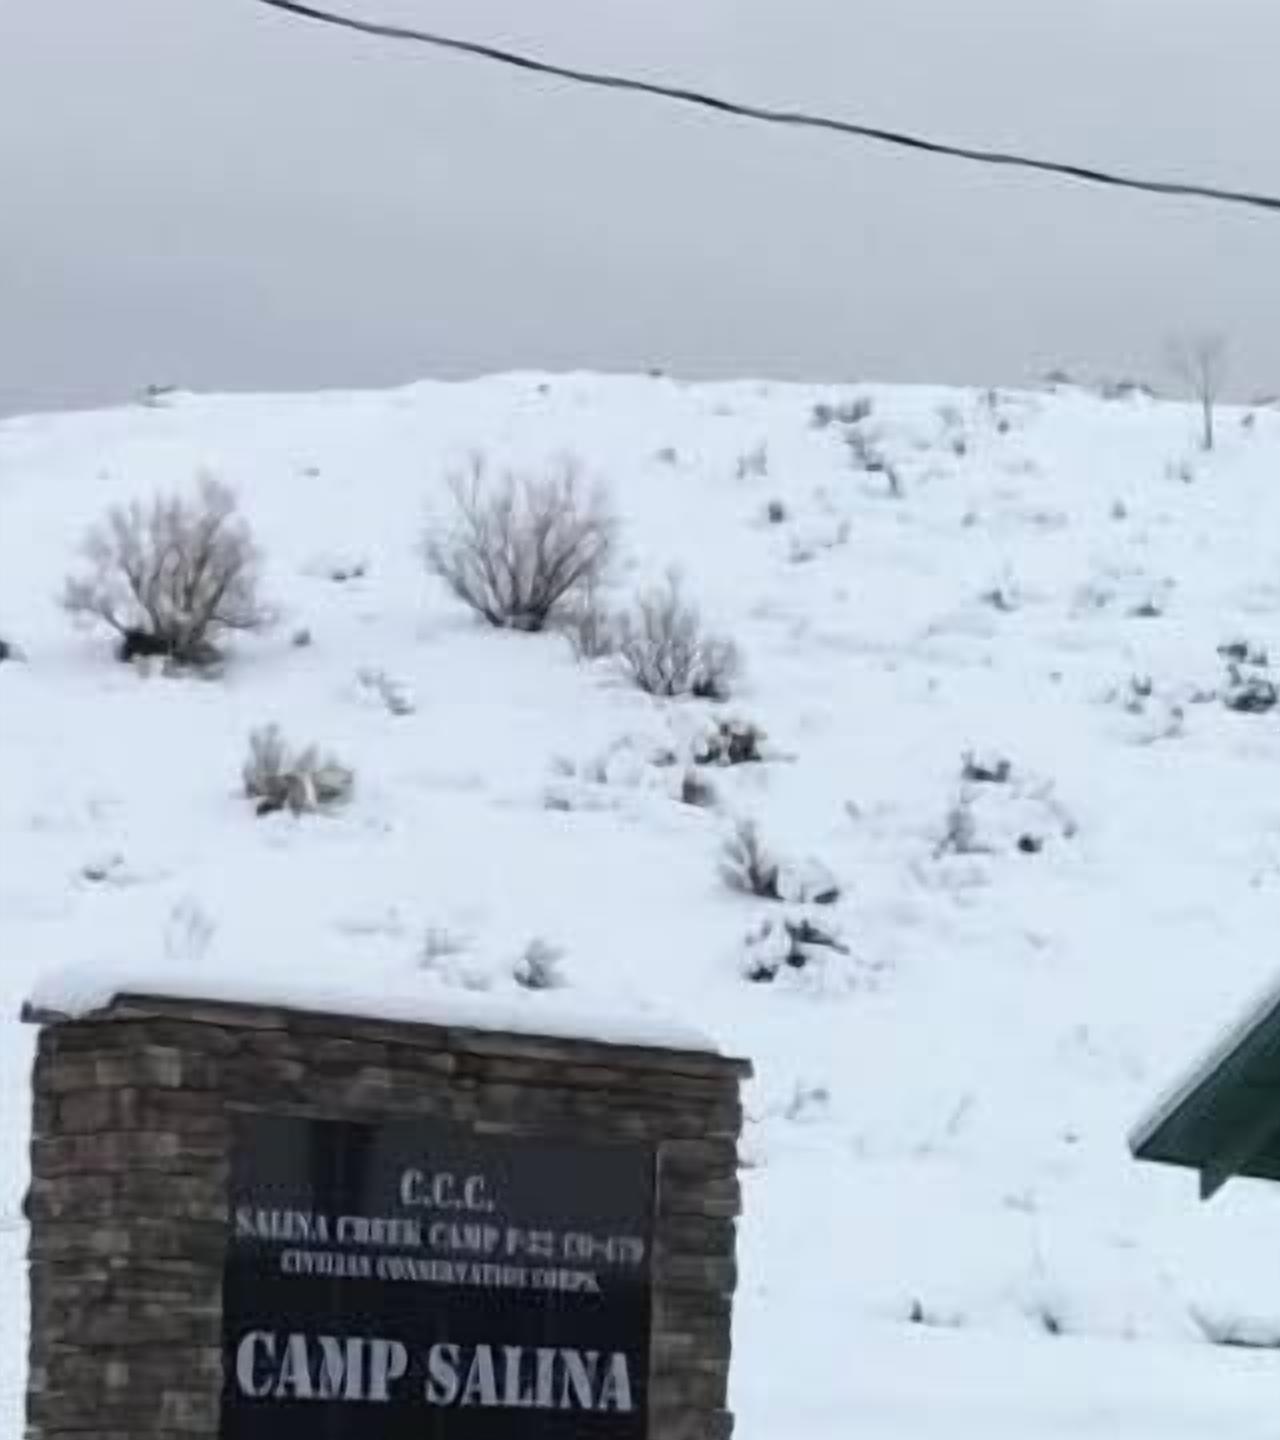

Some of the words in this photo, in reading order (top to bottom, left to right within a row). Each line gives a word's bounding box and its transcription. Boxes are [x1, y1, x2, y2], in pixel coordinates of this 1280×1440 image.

[400, 1166, 495, 1211] C.C.C.
[234, 1206, 328, 1241] SALINA
[335, 1214, 421, 1247] CREEK
[428, 1220, 501, 1254] CAMP
[280, 1249, 371, 1277] CIVILIAN
[376, 1252, 524, 1287] CONSERVATION
[530, 1267, 600, 1293] CORPS
[236, 1330, 409, 1402] CAMP
[425, 1342, 633, 1411] SALINA
